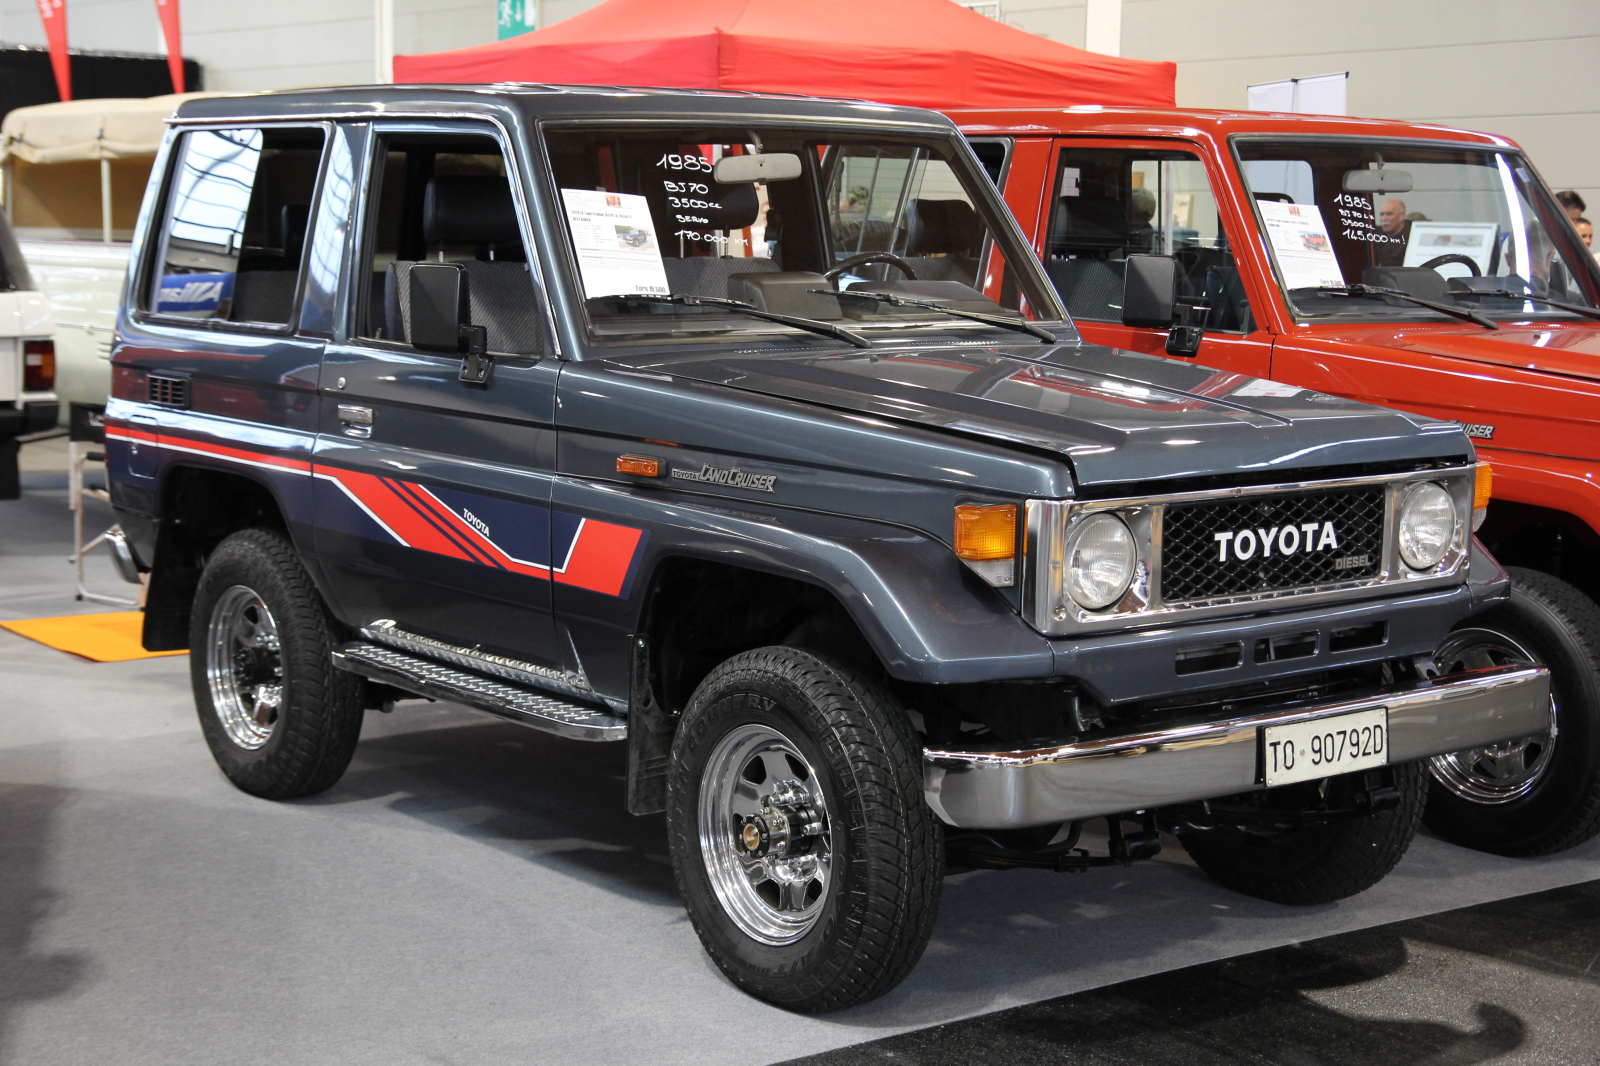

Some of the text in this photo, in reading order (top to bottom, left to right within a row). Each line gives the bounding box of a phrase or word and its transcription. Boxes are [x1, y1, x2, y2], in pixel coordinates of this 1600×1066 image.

[656, 153, 713, 173] 1985
[668, 197, 723, 209] 3500cc
[1333, 193, 1372, 211] 1985
[676, 214, 709, 224] SERVO
[674, 229, 729, 244] 170.000
[1342, 228, 1389, 243] 145.000
[635, 284, 649, 292] Euro
[672, 470, 697, 480] TOYOTA
[463, 507, 490, 537] TOYOTA
[1214, 521, 1338, 562] TOYOTA
[1334, 554, 1371, 571] DIESEL
[687, 693, 778, 756] COUNTRY
[1269, 724, 1384, 773] TO 90792D
